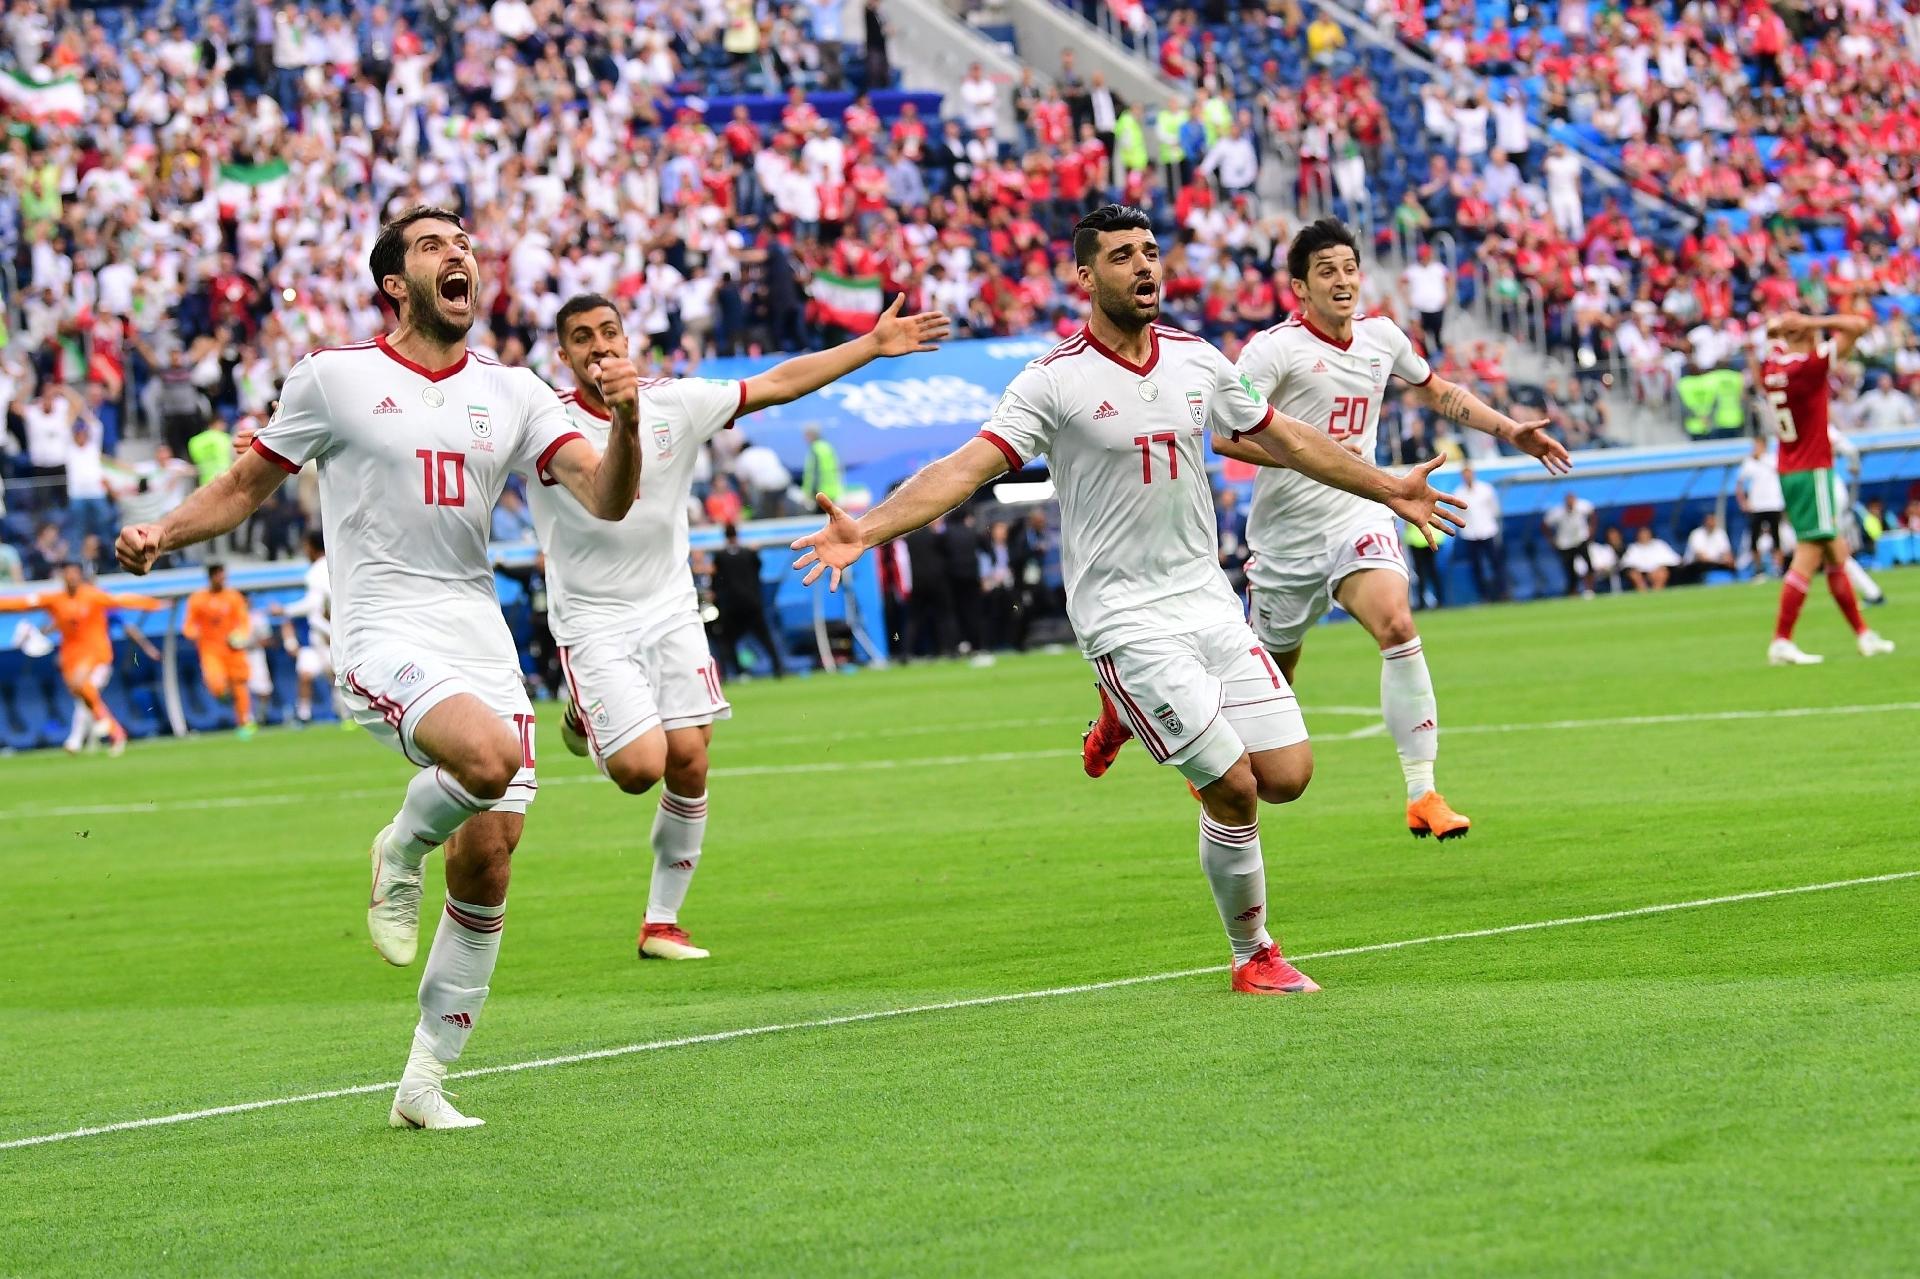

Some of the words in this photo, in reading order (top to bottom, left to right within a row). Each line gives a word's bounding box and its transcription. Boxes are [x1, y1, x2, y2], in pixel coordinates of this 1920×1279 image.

[1092, 409, 1119, 420] adidas
[1328, 397, 1368, 434] 20
[416, 449, 465, 507] 10
[1134, 432, 1177, 484] 17
